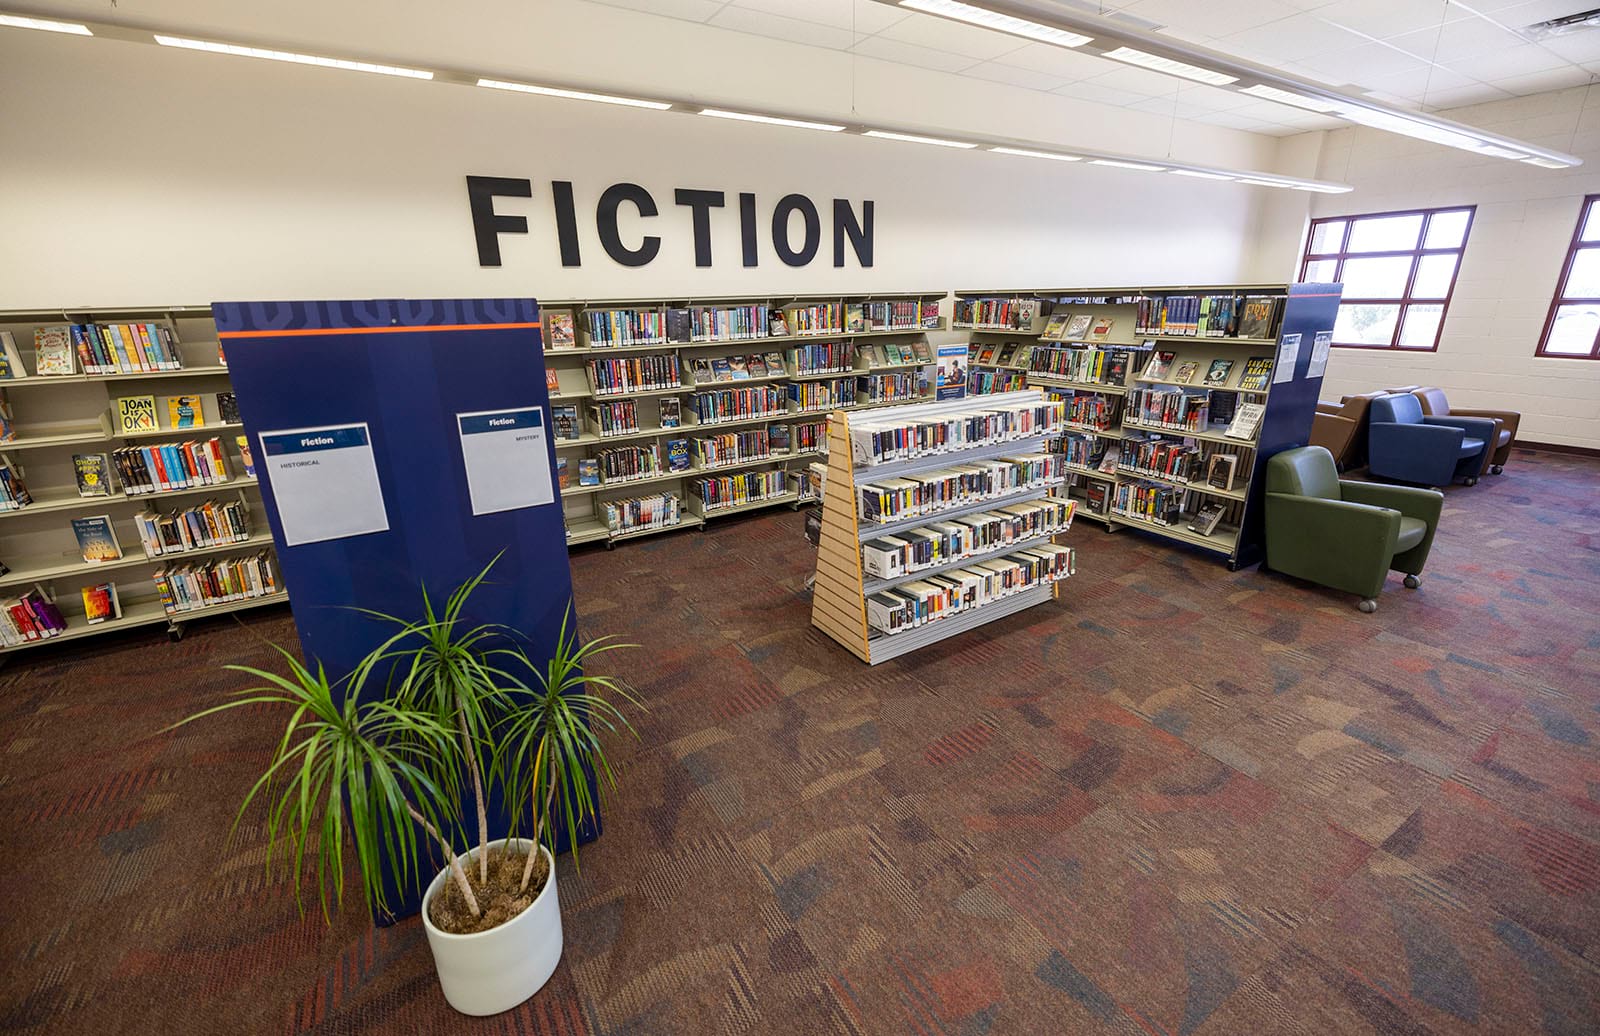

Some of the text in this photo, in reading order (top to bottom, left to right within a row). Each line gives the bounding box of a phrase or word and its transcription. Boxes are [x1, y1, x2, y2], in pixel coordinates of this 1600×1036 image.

[466, 175, 874, 268] FICTION
[121, 400, 152, 415] JOAN
[124, 409, 155, 429] OKAY
[489, 418, 515, 426] Fiction
[301, 437, 334, 447] Fiction
[671, 448, 687, 456] BOX
[280, 460, 320, 469] HISTORICAL
